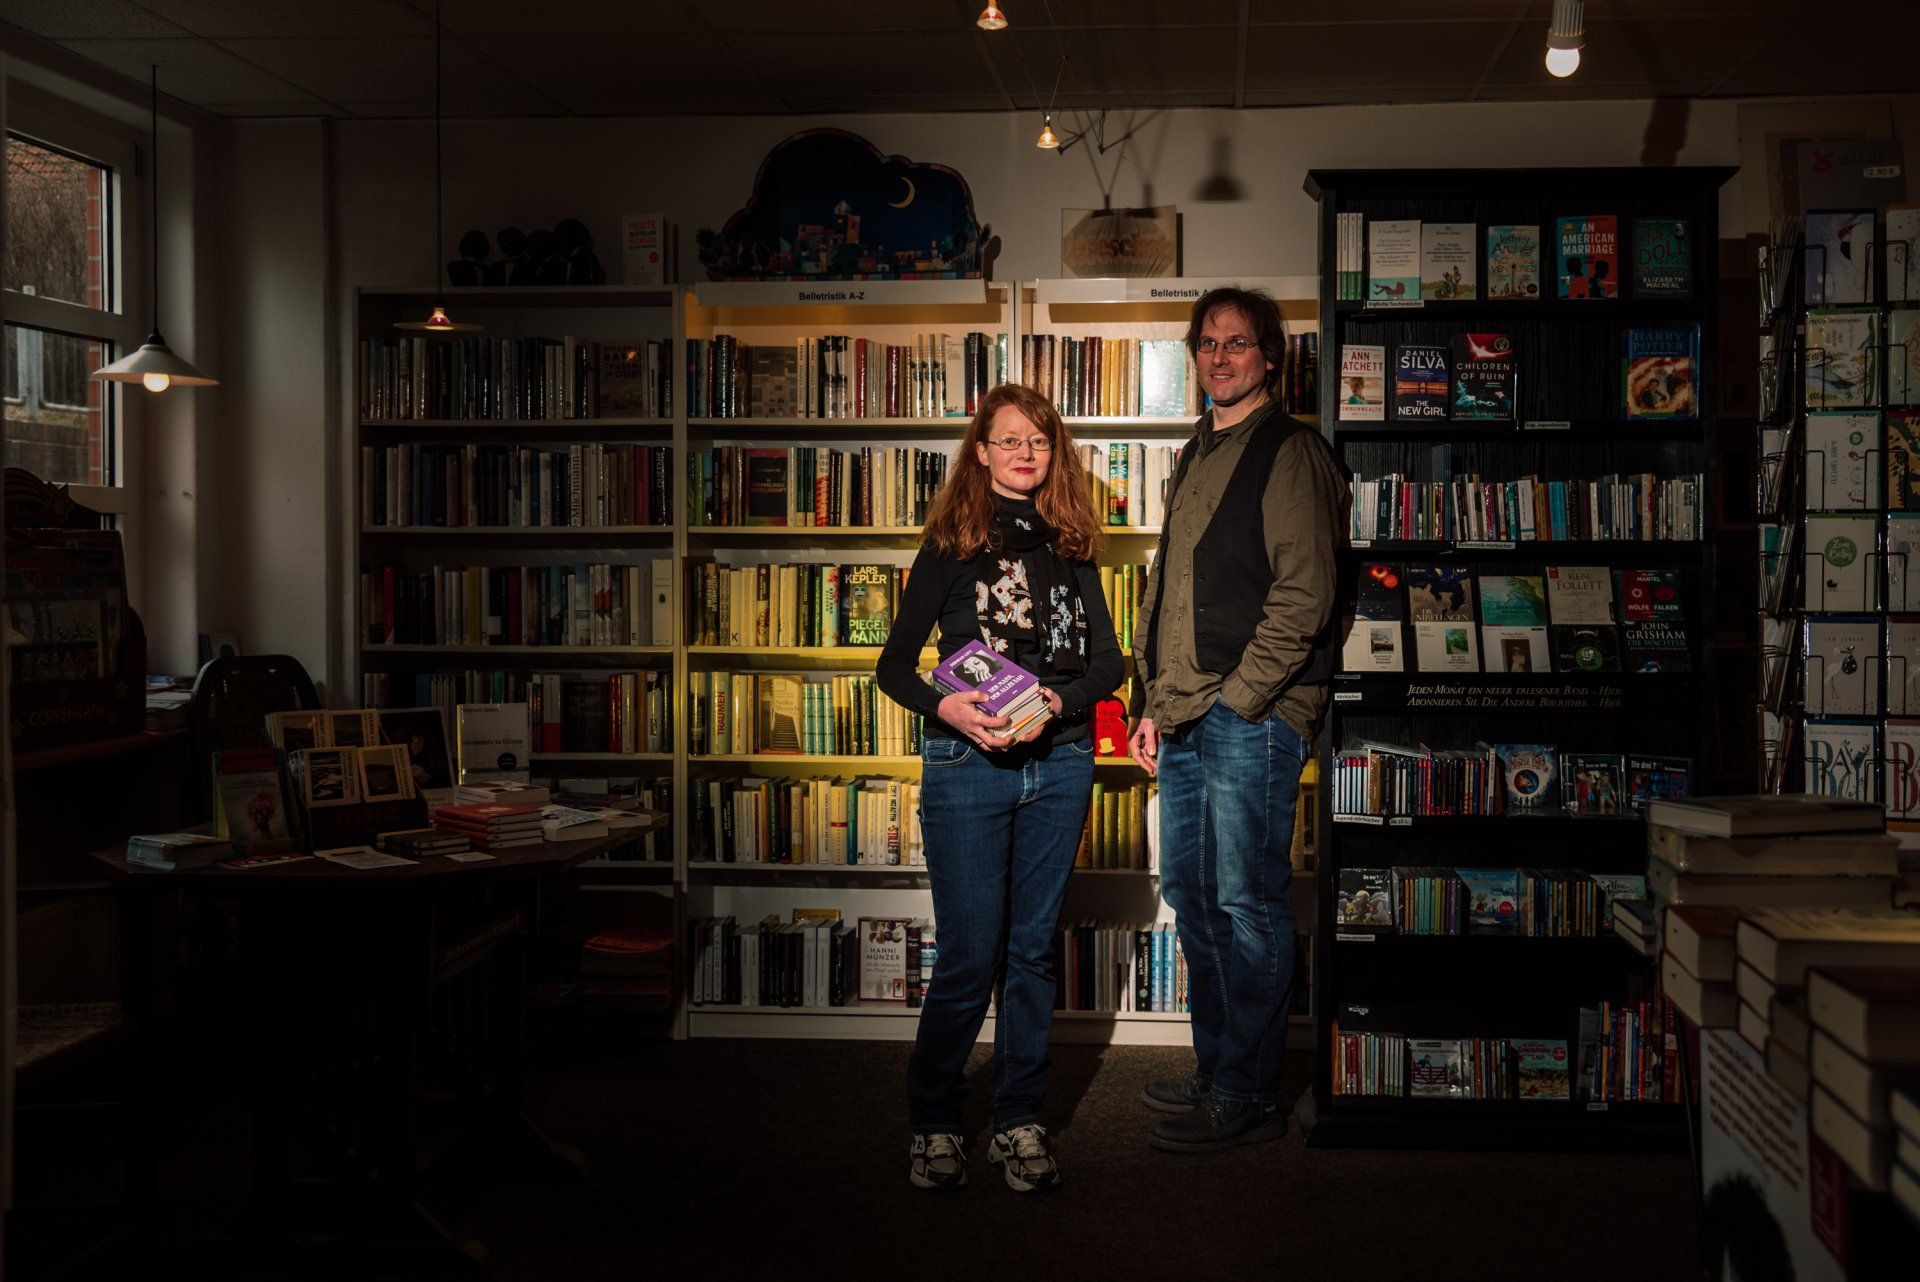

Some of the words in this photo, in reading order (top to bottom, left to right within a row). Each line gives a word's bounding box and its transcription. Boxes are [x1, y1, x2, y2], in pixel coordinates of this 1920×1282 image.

[629, 220, 657, 231] HEUTE
[1581, 222, 1595, 232] AN
[1562, 234, 1615, 244] AMERICAN
[1562, 244, 1615, 255] MARRIAGE
[1640, 239, 1689, 265] DOLL
[1643, 276, 1684, 284] ELIZABETH
[799, 292, 846, 301] Belletristik
[849, 292, 865, 300] A-Z
[1151, 289, 1199, 297] Belletristik
[1634, 331, 1683, 341] HARRY
[1632, 342, 1684, 351] POTTER
[1351, 352, 1370, 361] ANN
[1342, 361, 1383, 372] ATCHETT
[1400, 357, 1447, 369] SILVA
[1398, 406, 1422, 416] NEW
[1423, 406, 1447, 417] GIRL
[1119, 446, 1128, 463] Die
[572, 456, 581, 518] Milchmann
[1119, 464, 1128, 501] Wurzeln
[853, 566, 878, 575] LARS
[1568, 571, 1591, 580] KEN
[845, 574, 887, 584] KEPLER
[1556, 580, 1602, 591] FOLLETT
[1654, 603, 1679, 611] FALKEN
[849, 619, 888, 630] PIEGEL
[1641, 622, 1669, 630] JOHN
[849, 630, 889, 644] MANN
[1626, 629, 1686, 640] GRISHAM
[988, 685, 997, 693] DER
[989, 691, 1000, 701] DER
[999, 681, 1014, 693] ALLES
[1012, 674, 1025, 685] SAH
[31, 704, 105, 727] COPPENRATH
